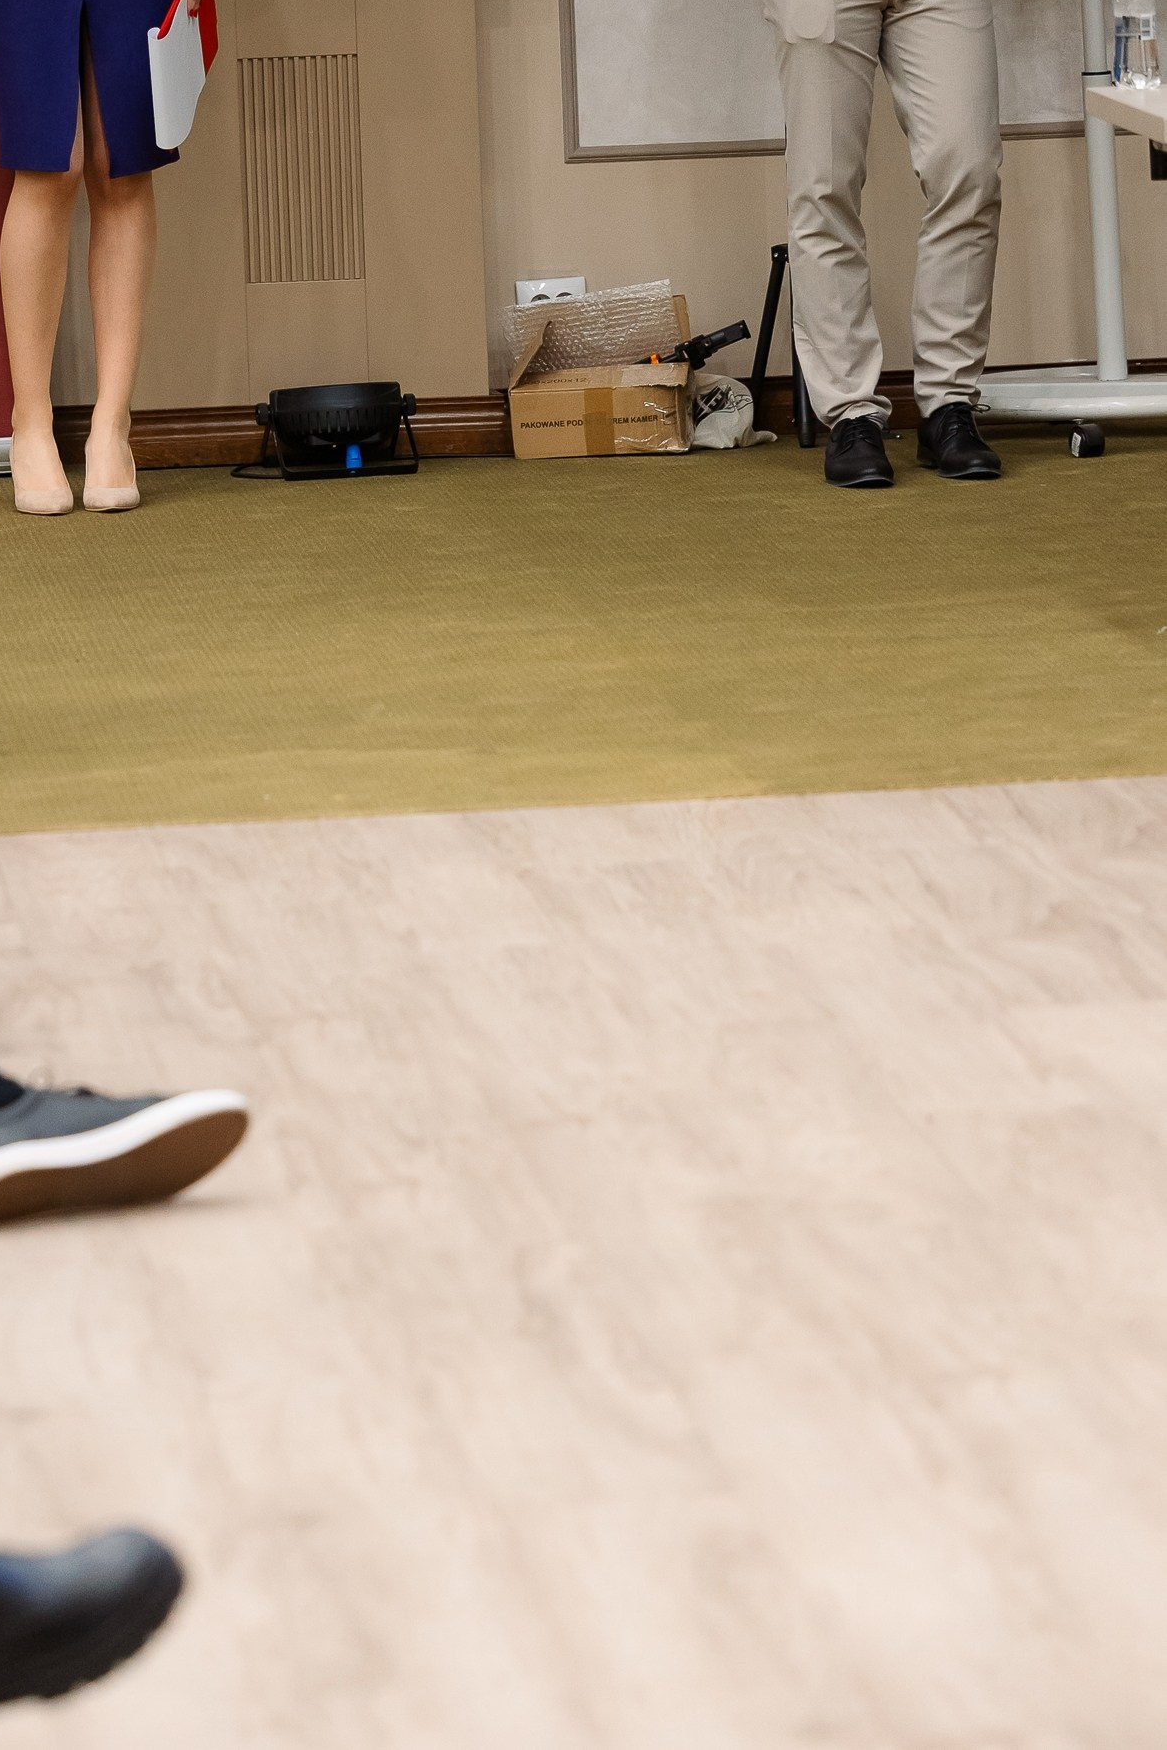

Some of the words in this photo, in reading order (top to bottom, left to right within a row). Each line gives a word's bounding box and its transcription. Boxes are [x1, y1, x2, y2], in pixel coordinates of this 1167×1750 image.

[520, 419, 565, 430] PAKOWANE
[566, 419, 584, 427] POD
[630, 414, 659, 424] KAMER
